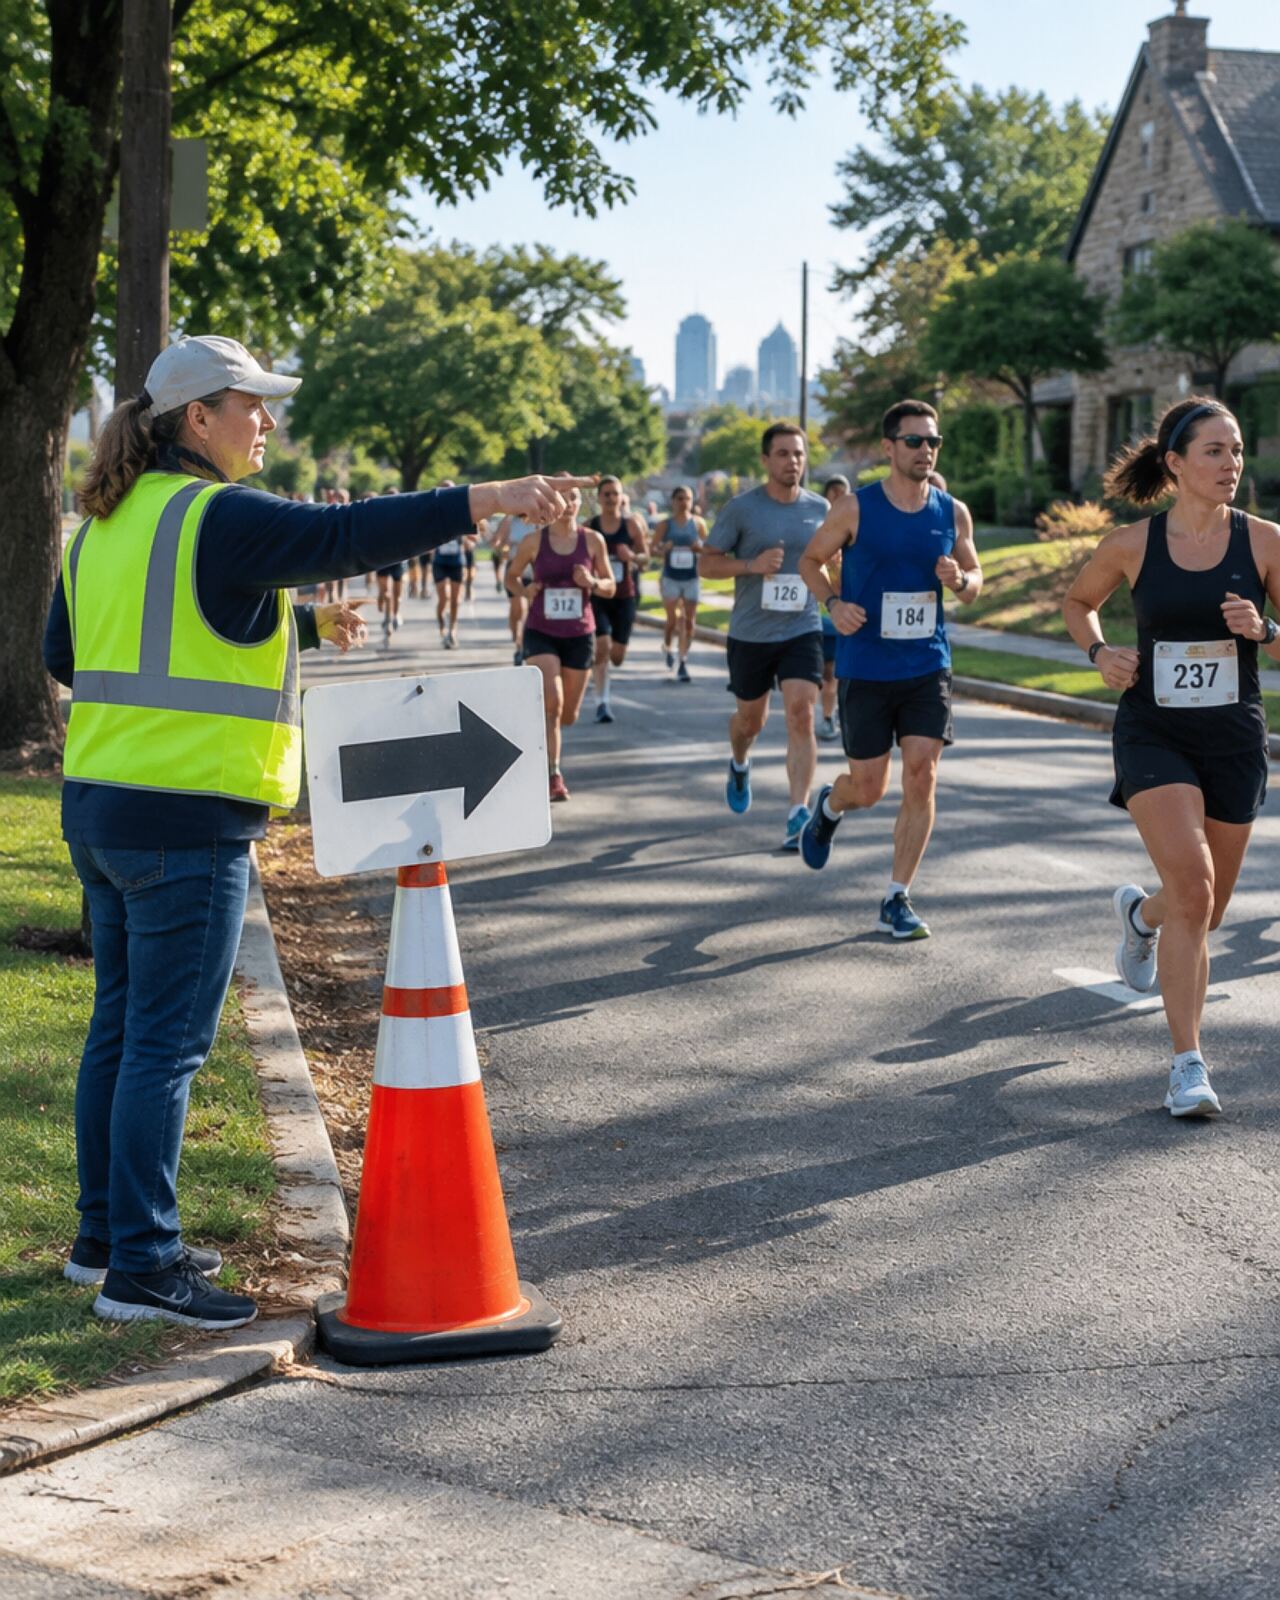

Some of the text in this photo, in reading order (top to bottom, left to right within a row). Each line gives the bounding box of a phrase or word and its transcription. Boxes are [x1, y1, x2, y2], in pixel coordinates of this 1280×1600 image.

[774, 586, 798, 601] 126
[552, 598, 575, 611] 312
[896, 607, 924, 626] 184
[1174, 662, 1219, 689] 237
